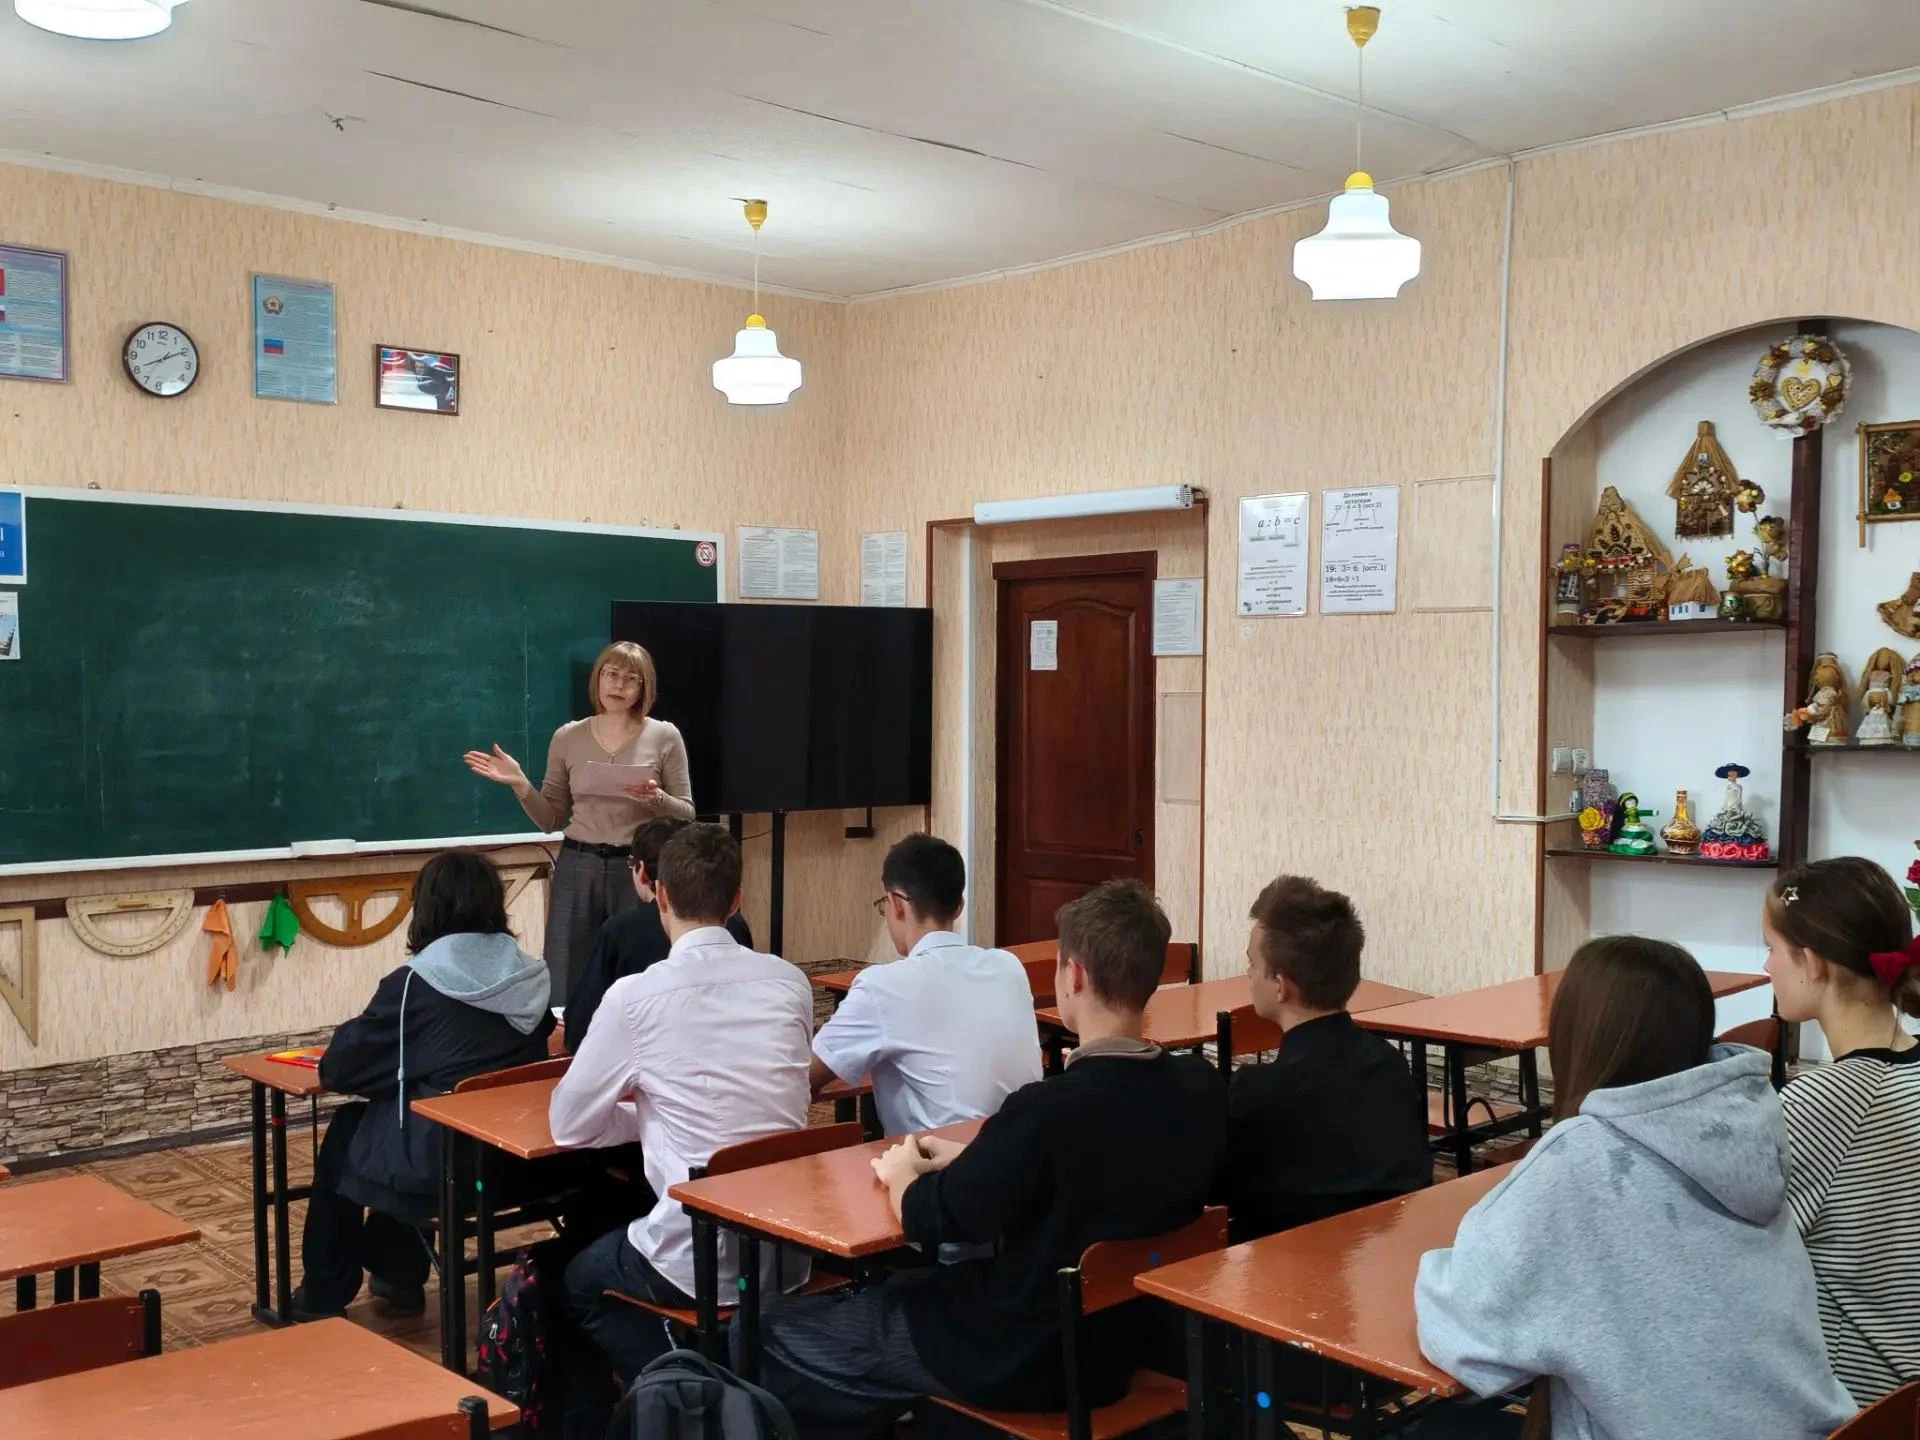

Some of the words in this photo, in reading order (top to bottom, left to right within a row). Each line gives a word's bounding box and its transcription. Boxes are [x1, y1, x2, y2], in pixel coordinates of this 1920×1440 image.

[147, 331, 155, 340] 11
[158, 330, 168, 340] 12
[136, 339, 146, 348] 10
[130, 351, 138, 360] 9
[180, 348, 188, 357] 2
[134, 366, 140, 374] 8
[184, 361, 191, 370] 3
[144, 376, 150, 384] 7
[178, 373, 185, 381] 4
[155, 382, 162, 390] 6
